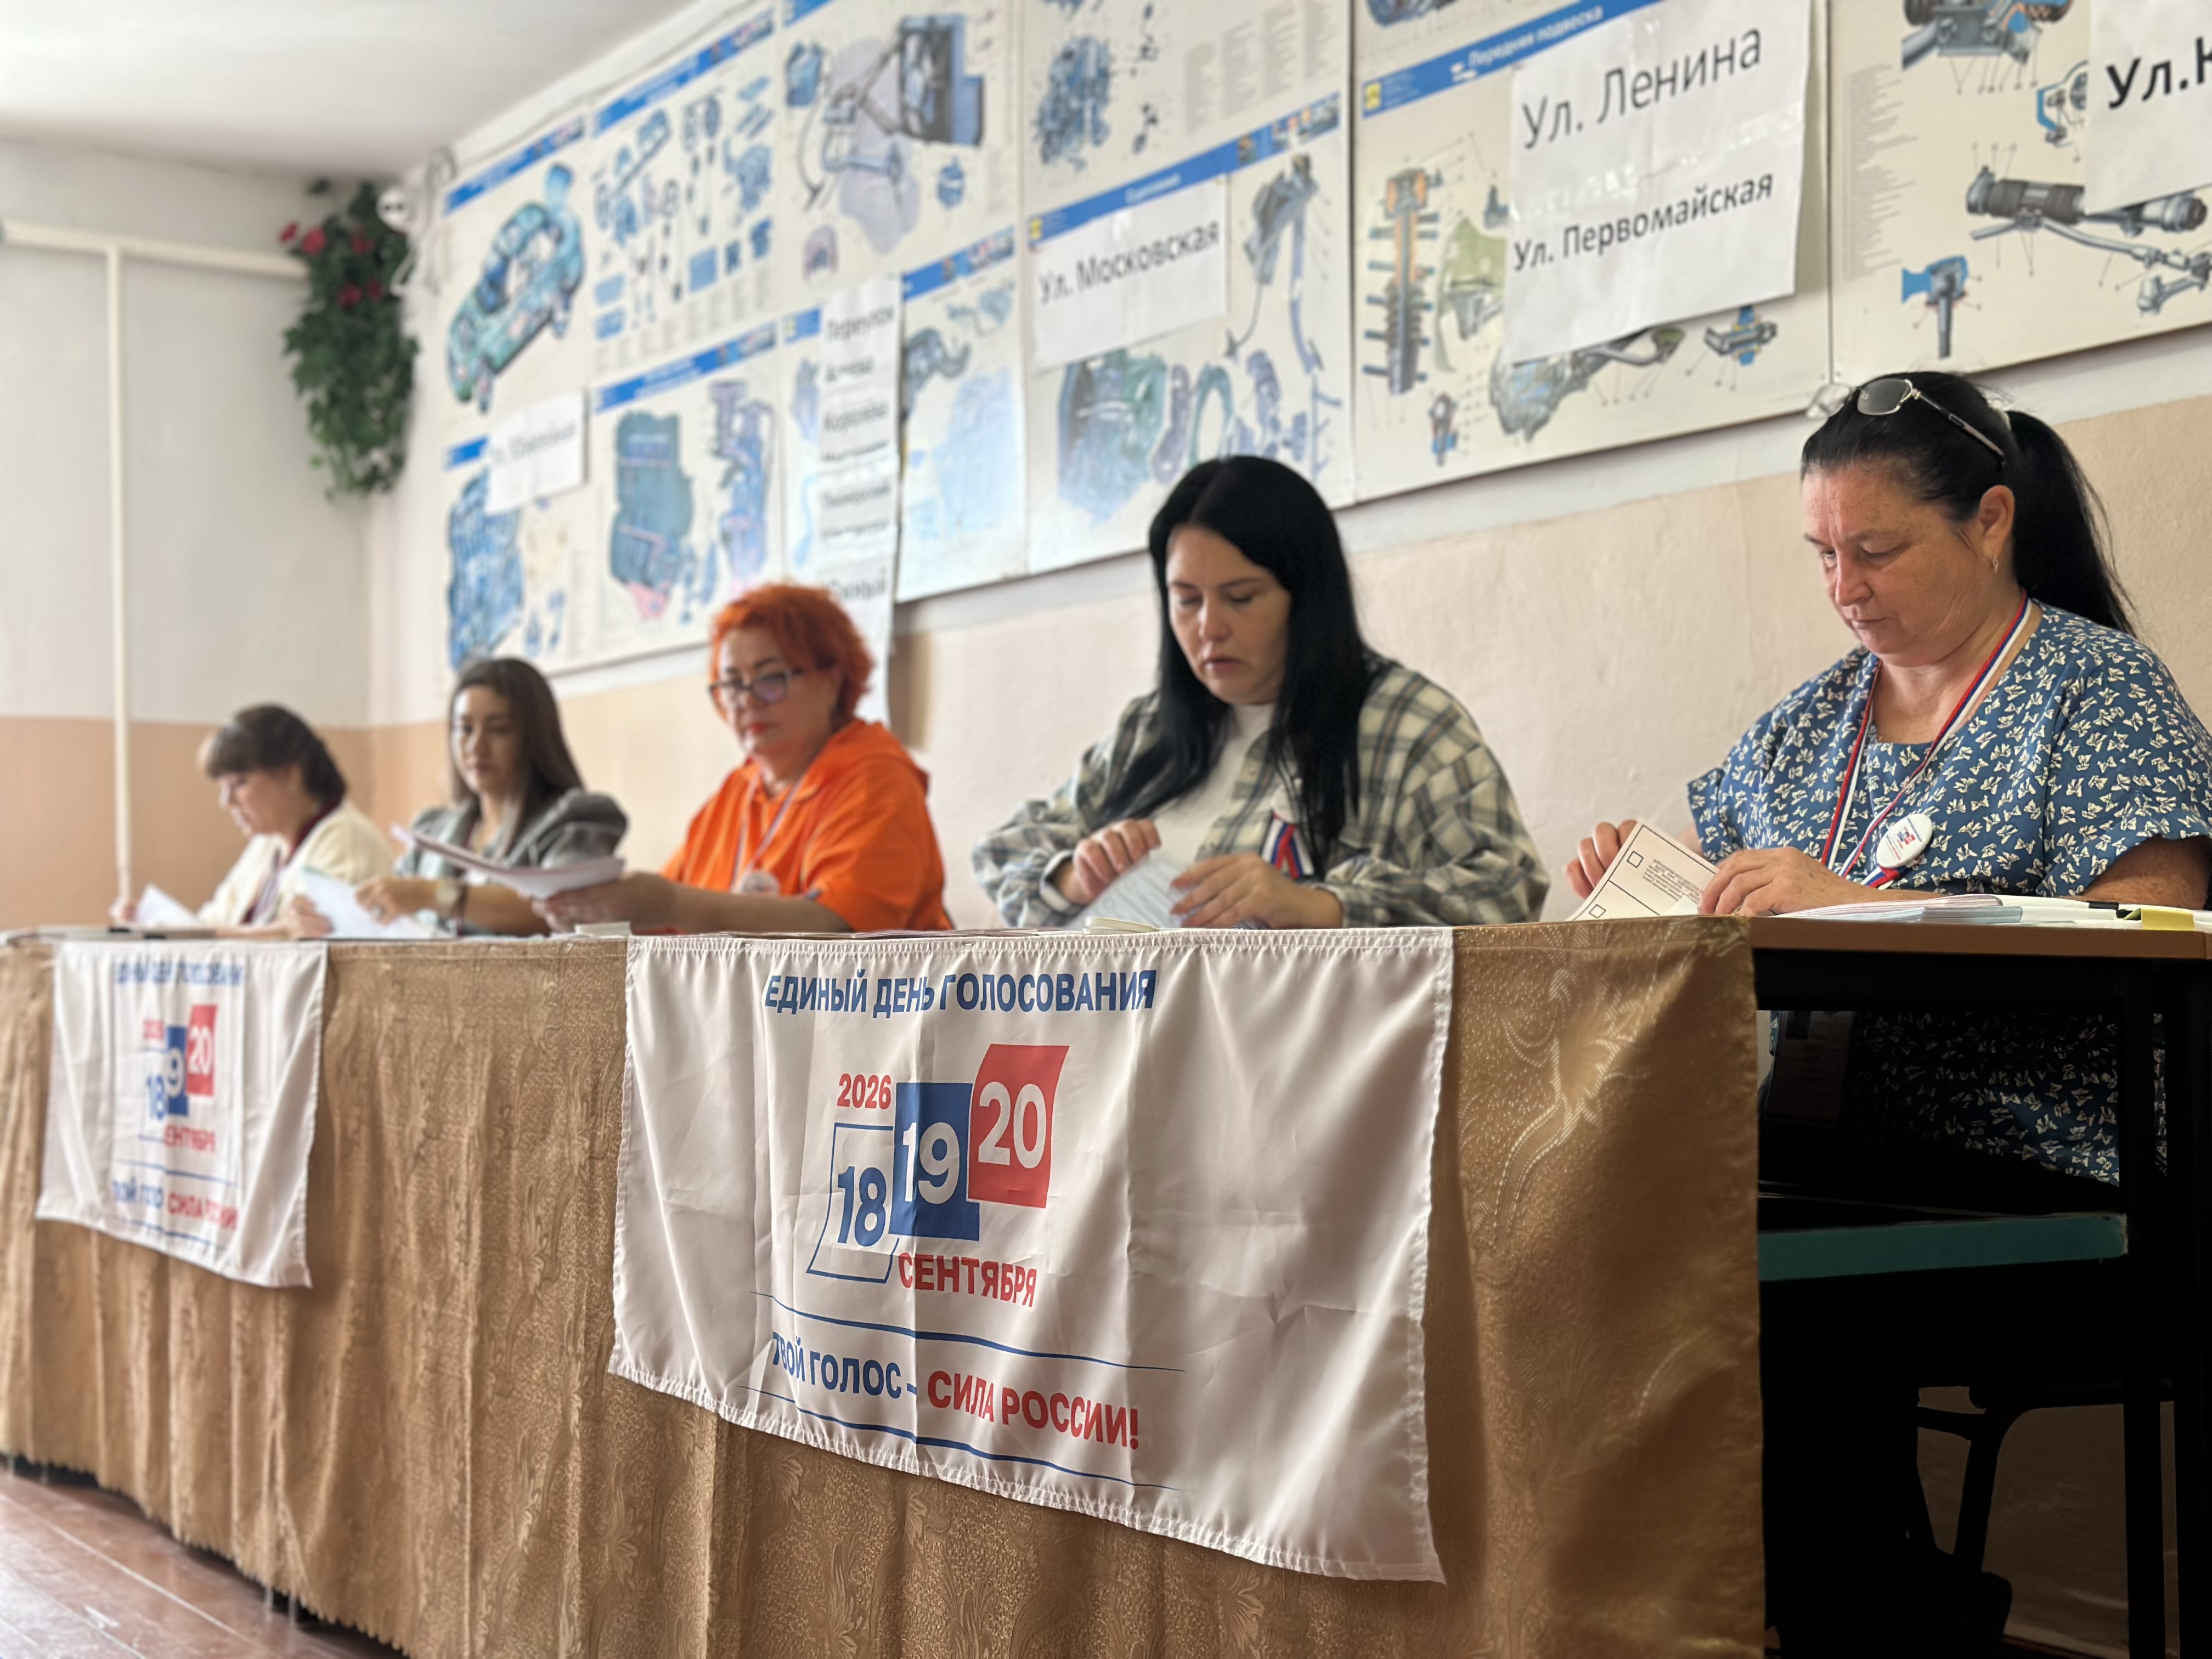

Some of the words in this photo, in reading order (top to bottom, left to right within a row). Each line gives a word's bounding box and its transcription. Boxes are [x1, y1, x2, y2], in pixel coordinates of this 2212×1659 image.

[1522, 97, 1583, 149] Ул.
[1598, 28, 1762, 123] Ленина
[1039, 273, 1074, 305] Ул.
[1076, 221, 1219, 292] Московская
[1514, 240, 1554, 271] Ул.
[1563, 173, 1773, 260] Первомайская
[765, 969, 867, 1014] ЕДИНЫЙ
[872, 976, 933, 1019] ДЕНЬ
[939, 969, 1157, 1012] ГОЛОСОВАНИЯ
[166, 1047, 185, 1098] 9
[189, 1026, 212, 1076] 20
[837, 1073, 892, 1109] 2026
[902, 1122, 961, 1205] 19
[978, 1081, 1047, 1169] 20
[837, 1166, 887, 1247] 18
[898, 1252, 1037, 1308] СЕНТЯБРЯ
[810, 1351, 902, 1400] ГОЛОС
[928, 1370, 995, 1423] СИЛА
[1002, 1387, 1139, 1450] РОССИИ!
